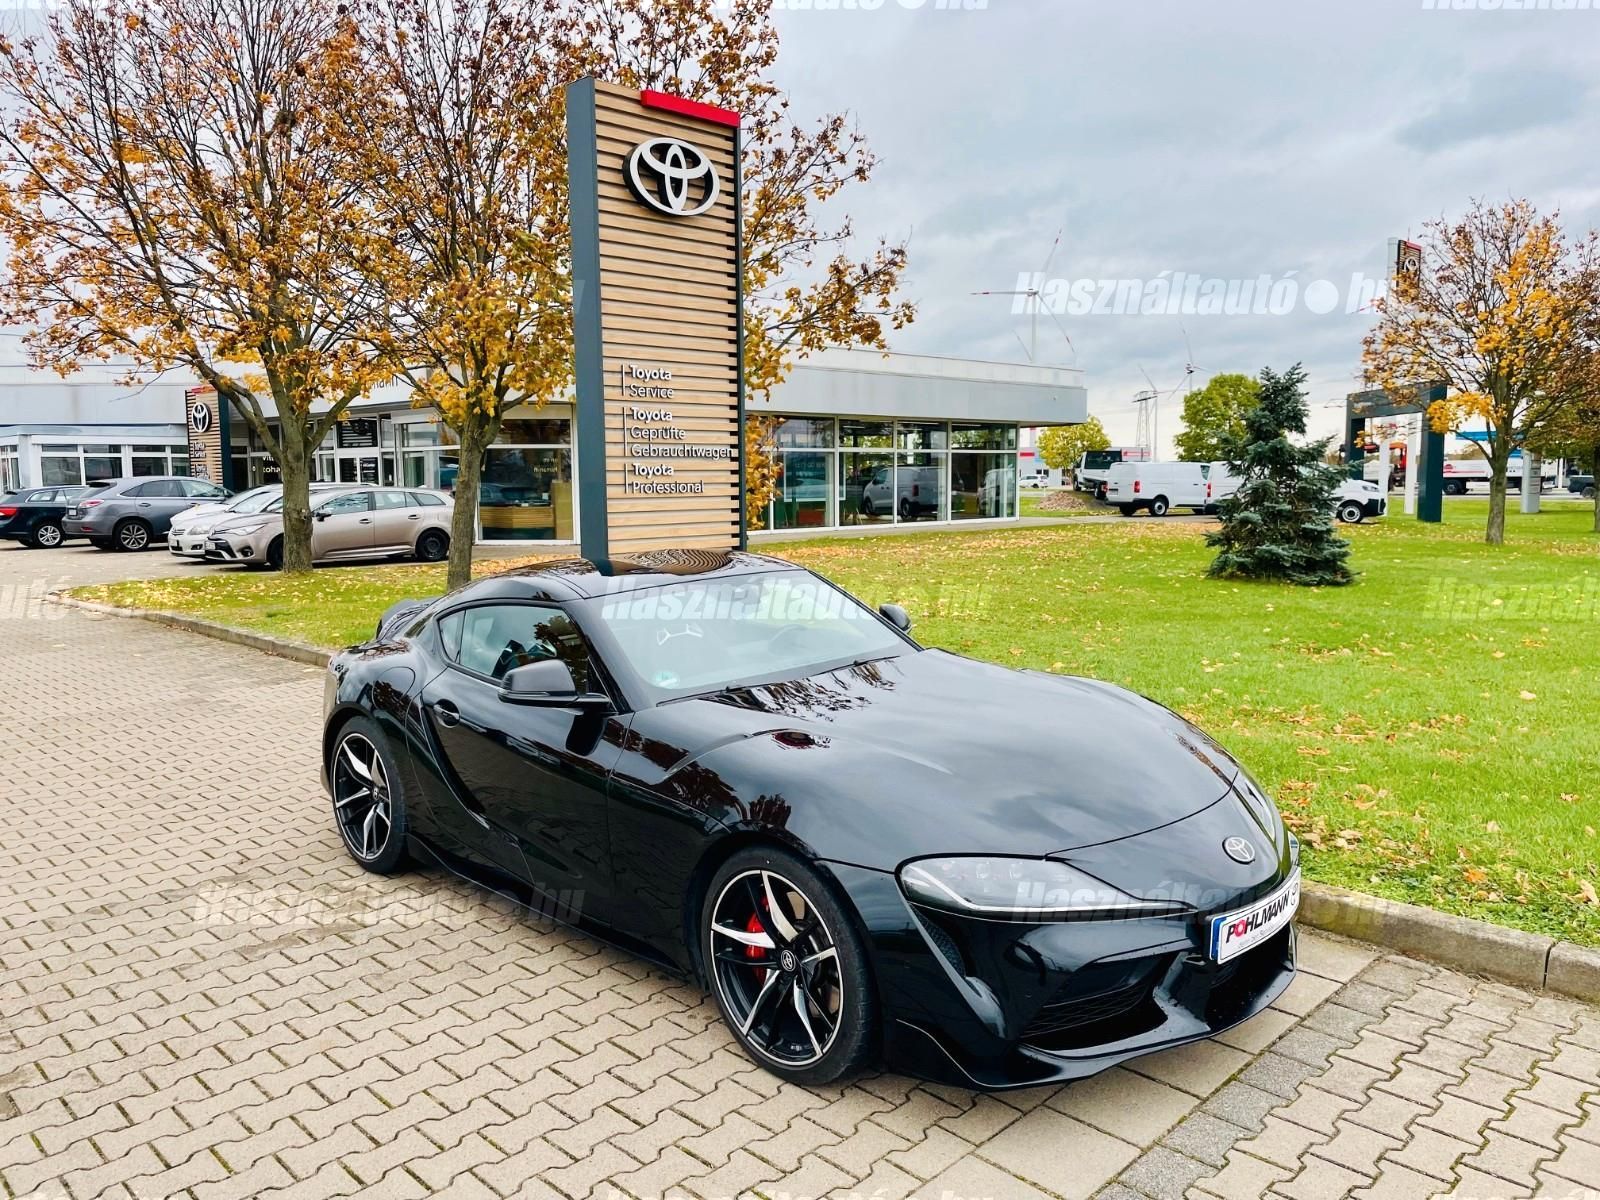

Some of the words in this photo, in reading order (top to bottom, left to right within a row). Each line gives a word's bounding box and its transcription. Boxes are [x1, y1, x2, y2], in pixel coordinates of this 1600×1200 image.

[629, 364, 672, 382] Toyota
[629, 384, 675, 399] Service
[630, 406, 673, 424] Toyota
[630, 426, 686, 441] Geprüfte
[631, 444, 733, 461] Gebrauchtwagen
[632, 463, 675, 479] Toyota
[631, 480, 705, 494] Professional
[1226, 890, 1290, 944] POHLMANN
